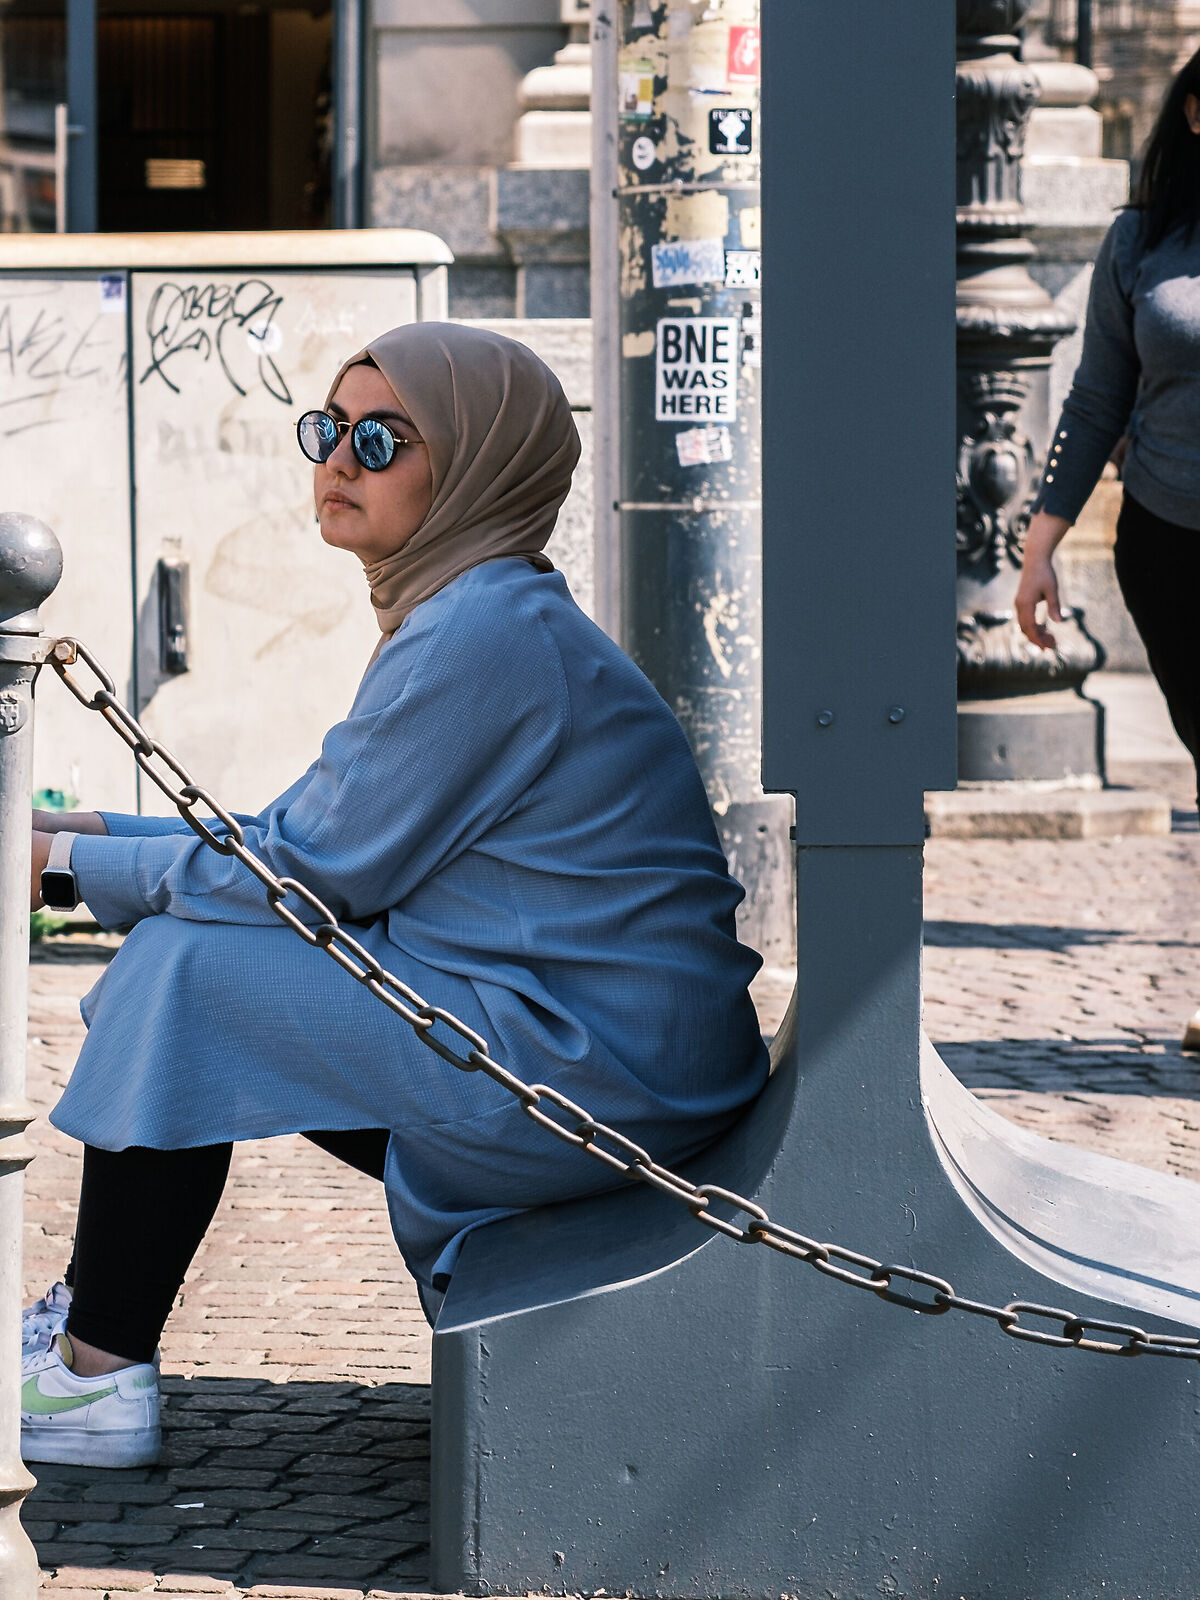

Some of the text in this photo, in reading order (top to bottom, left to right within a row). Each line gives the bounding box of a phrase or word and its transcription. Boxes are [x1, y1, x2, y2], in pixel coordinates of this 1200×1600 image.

[662, 324, 729, 364] BNE
[662, 369, 728, 389] WAS
[661, 395, 729, 415] HERE
